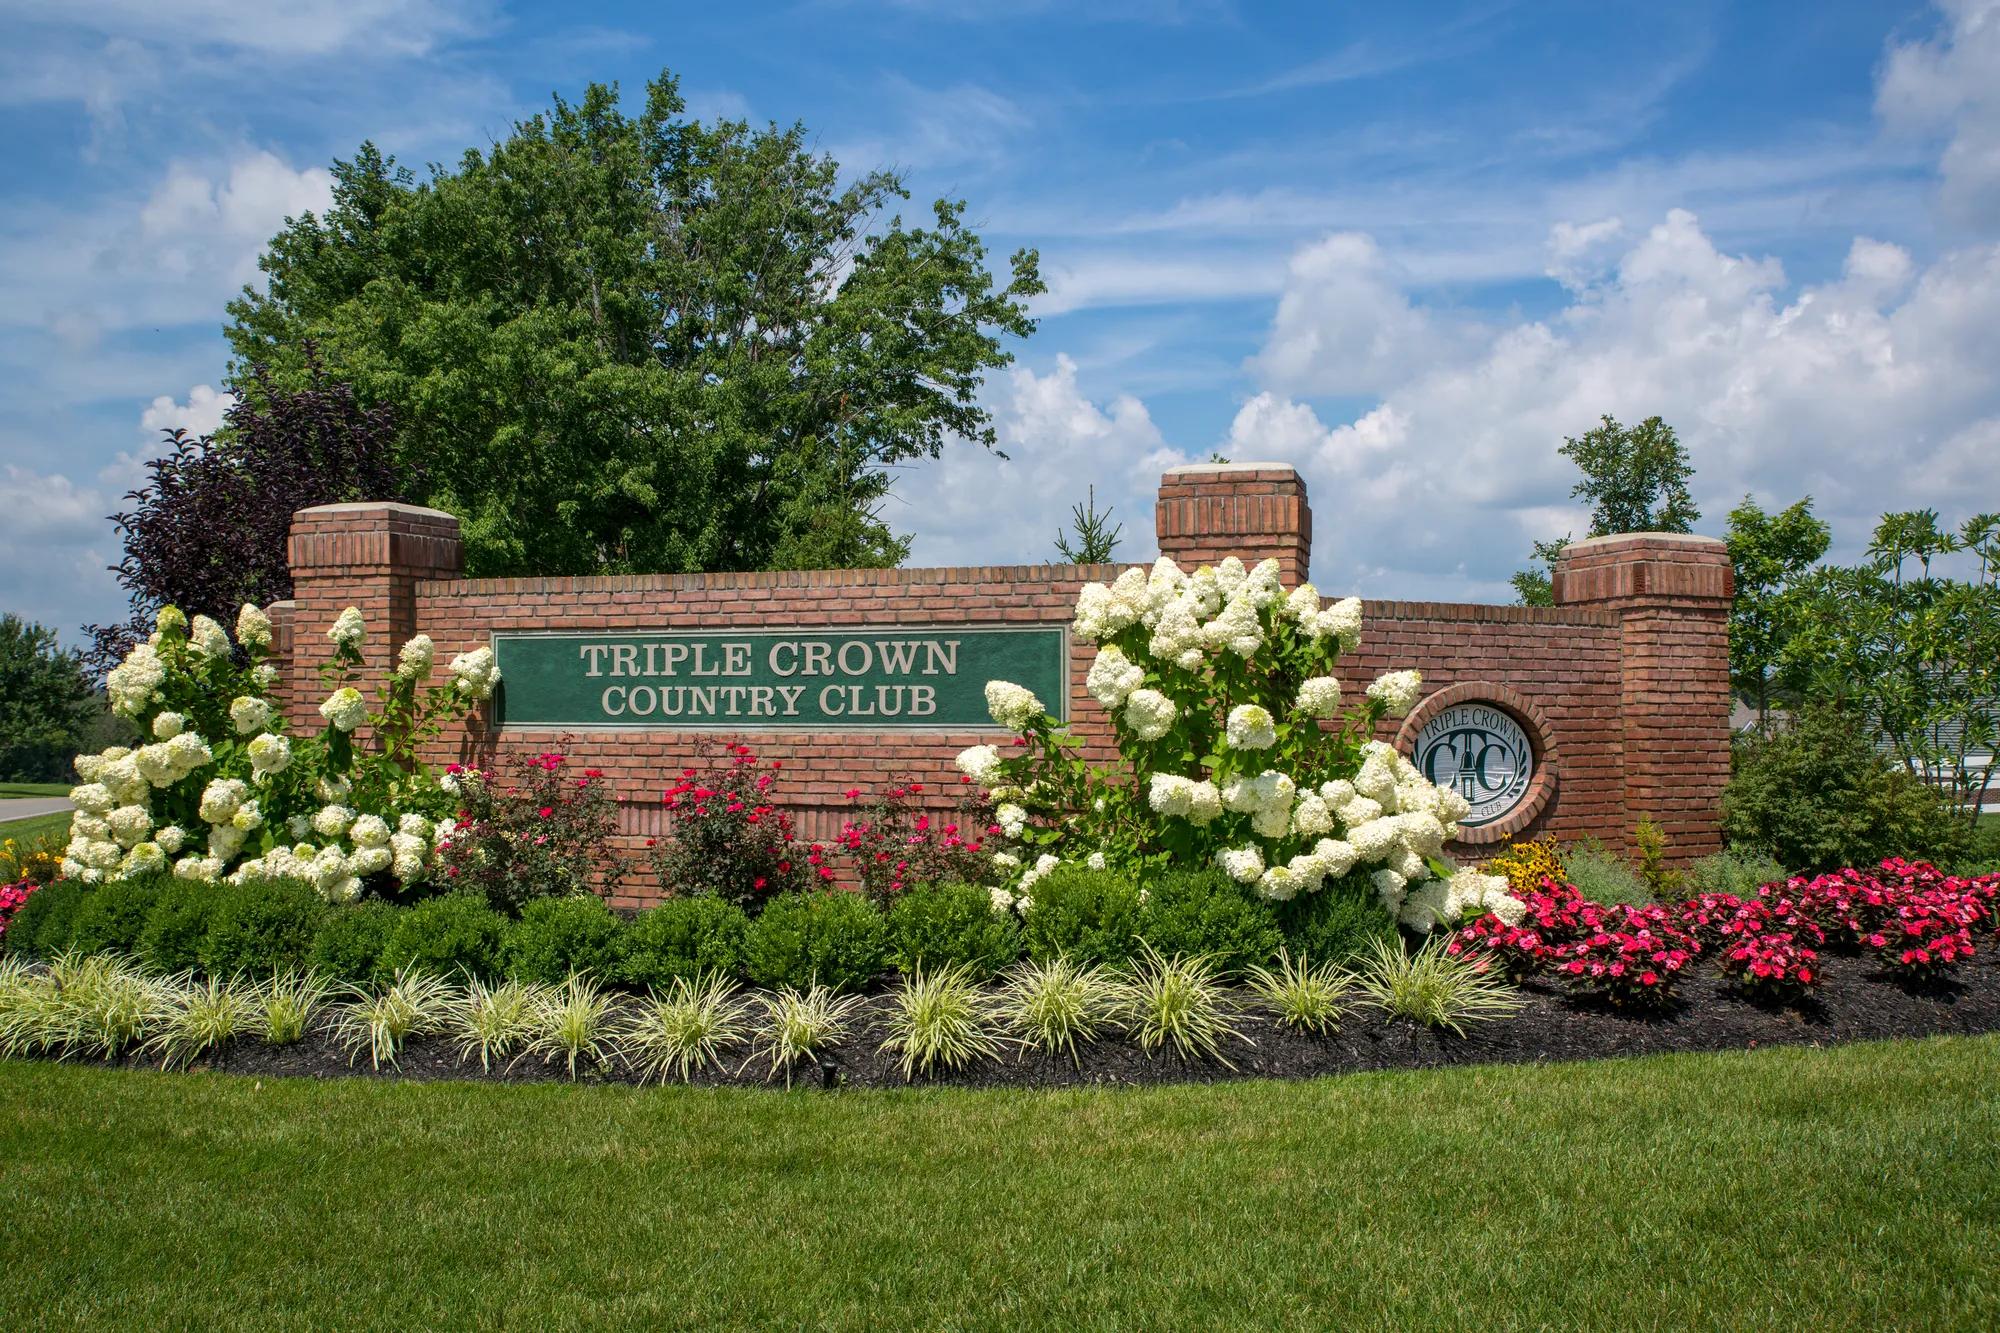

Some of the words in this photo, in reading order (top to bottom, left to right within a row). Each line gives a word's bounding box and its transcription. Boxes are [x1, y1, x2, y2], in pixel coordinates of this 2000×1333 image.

[580, 643, 752, 677] TRIPLE
[768, 640, 961, 676] CROWN
[601, 686, 806, 716] COUNTRY
[819, 685, 937, 716] CLUB
[1423, 708, 1470, 740] TRIPLE
[1472, 708, 1520, 744] CROWN
[1481, 801, 1502, 817] CLUB
